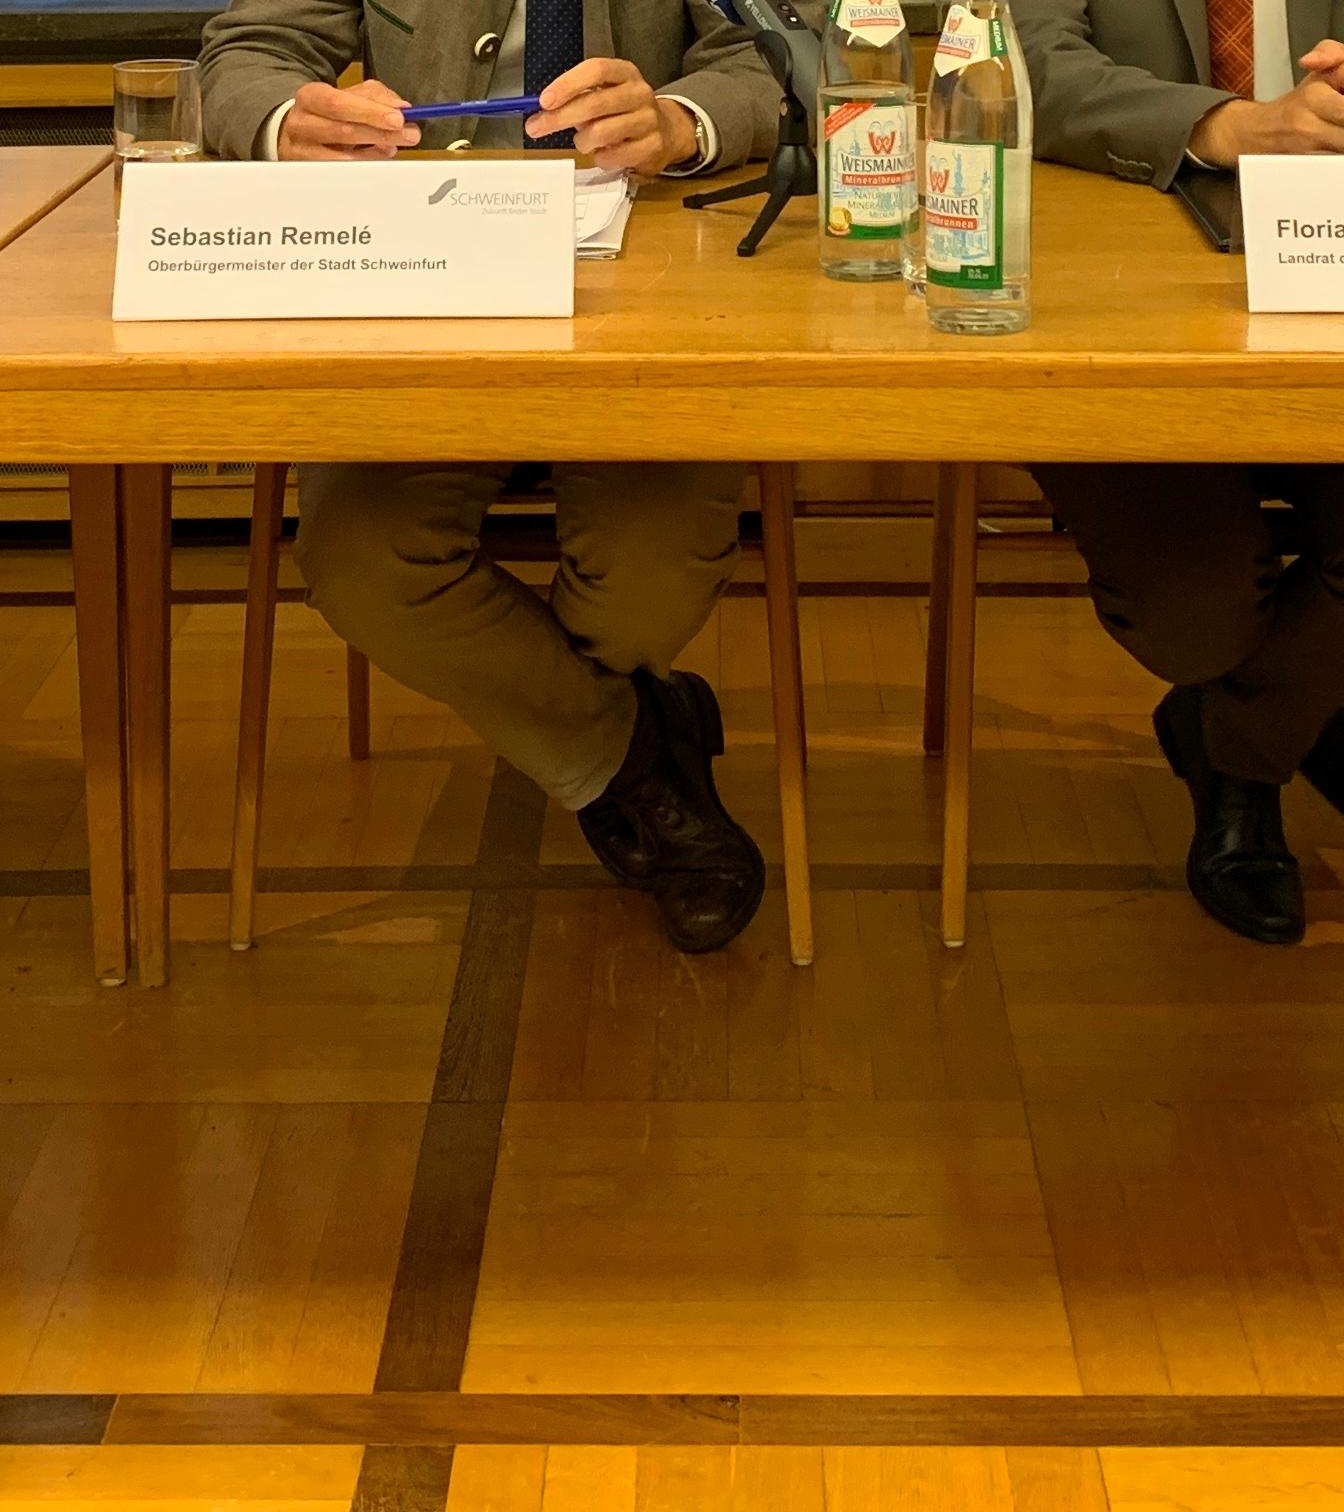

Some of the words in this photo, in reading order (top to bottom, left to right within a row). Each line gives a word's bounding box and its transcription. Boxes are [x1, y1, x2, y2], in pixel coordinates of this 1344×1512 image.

[450, 192, 550, 206] SCHWEINFURT
[150, 226, 271, 246] Sebastian
[281, 225, 372, 246] Remelé
[147, 259, 285, 274] Oberbürgermeister
[289, 259, 315, 271] der
[317, 258, 356, 271] Stadt
[359, 257, 447, 271] Schweinfurt
[1278, 252, 1335, 265] Landrat
